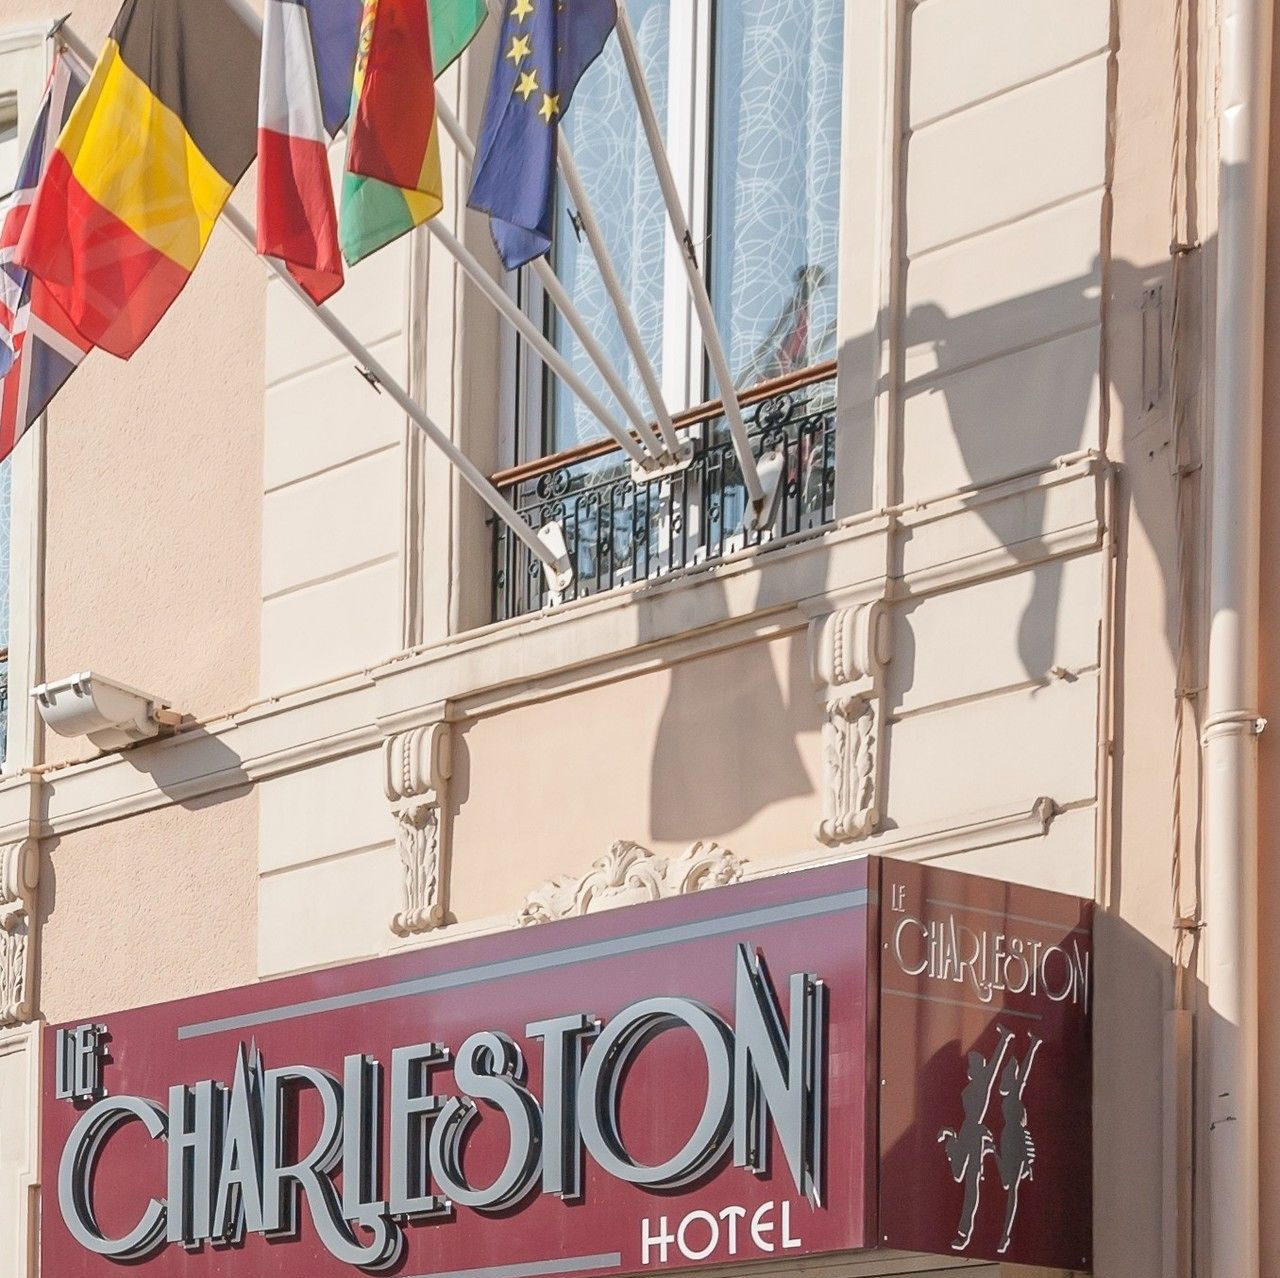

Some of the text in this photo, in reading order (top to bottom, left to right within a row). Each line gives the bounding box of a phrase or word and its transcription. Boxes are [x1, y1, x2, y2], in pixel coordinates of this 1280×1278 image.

[891, 882, 906, 912] LE
[895, 913, 1090, 1015] CHARLESTON
[55, 1023, 108, 1102] LE
[57, 942, 820, 1268] CHARLESTON
[641, 1200, 802, 1265] HOTEL
